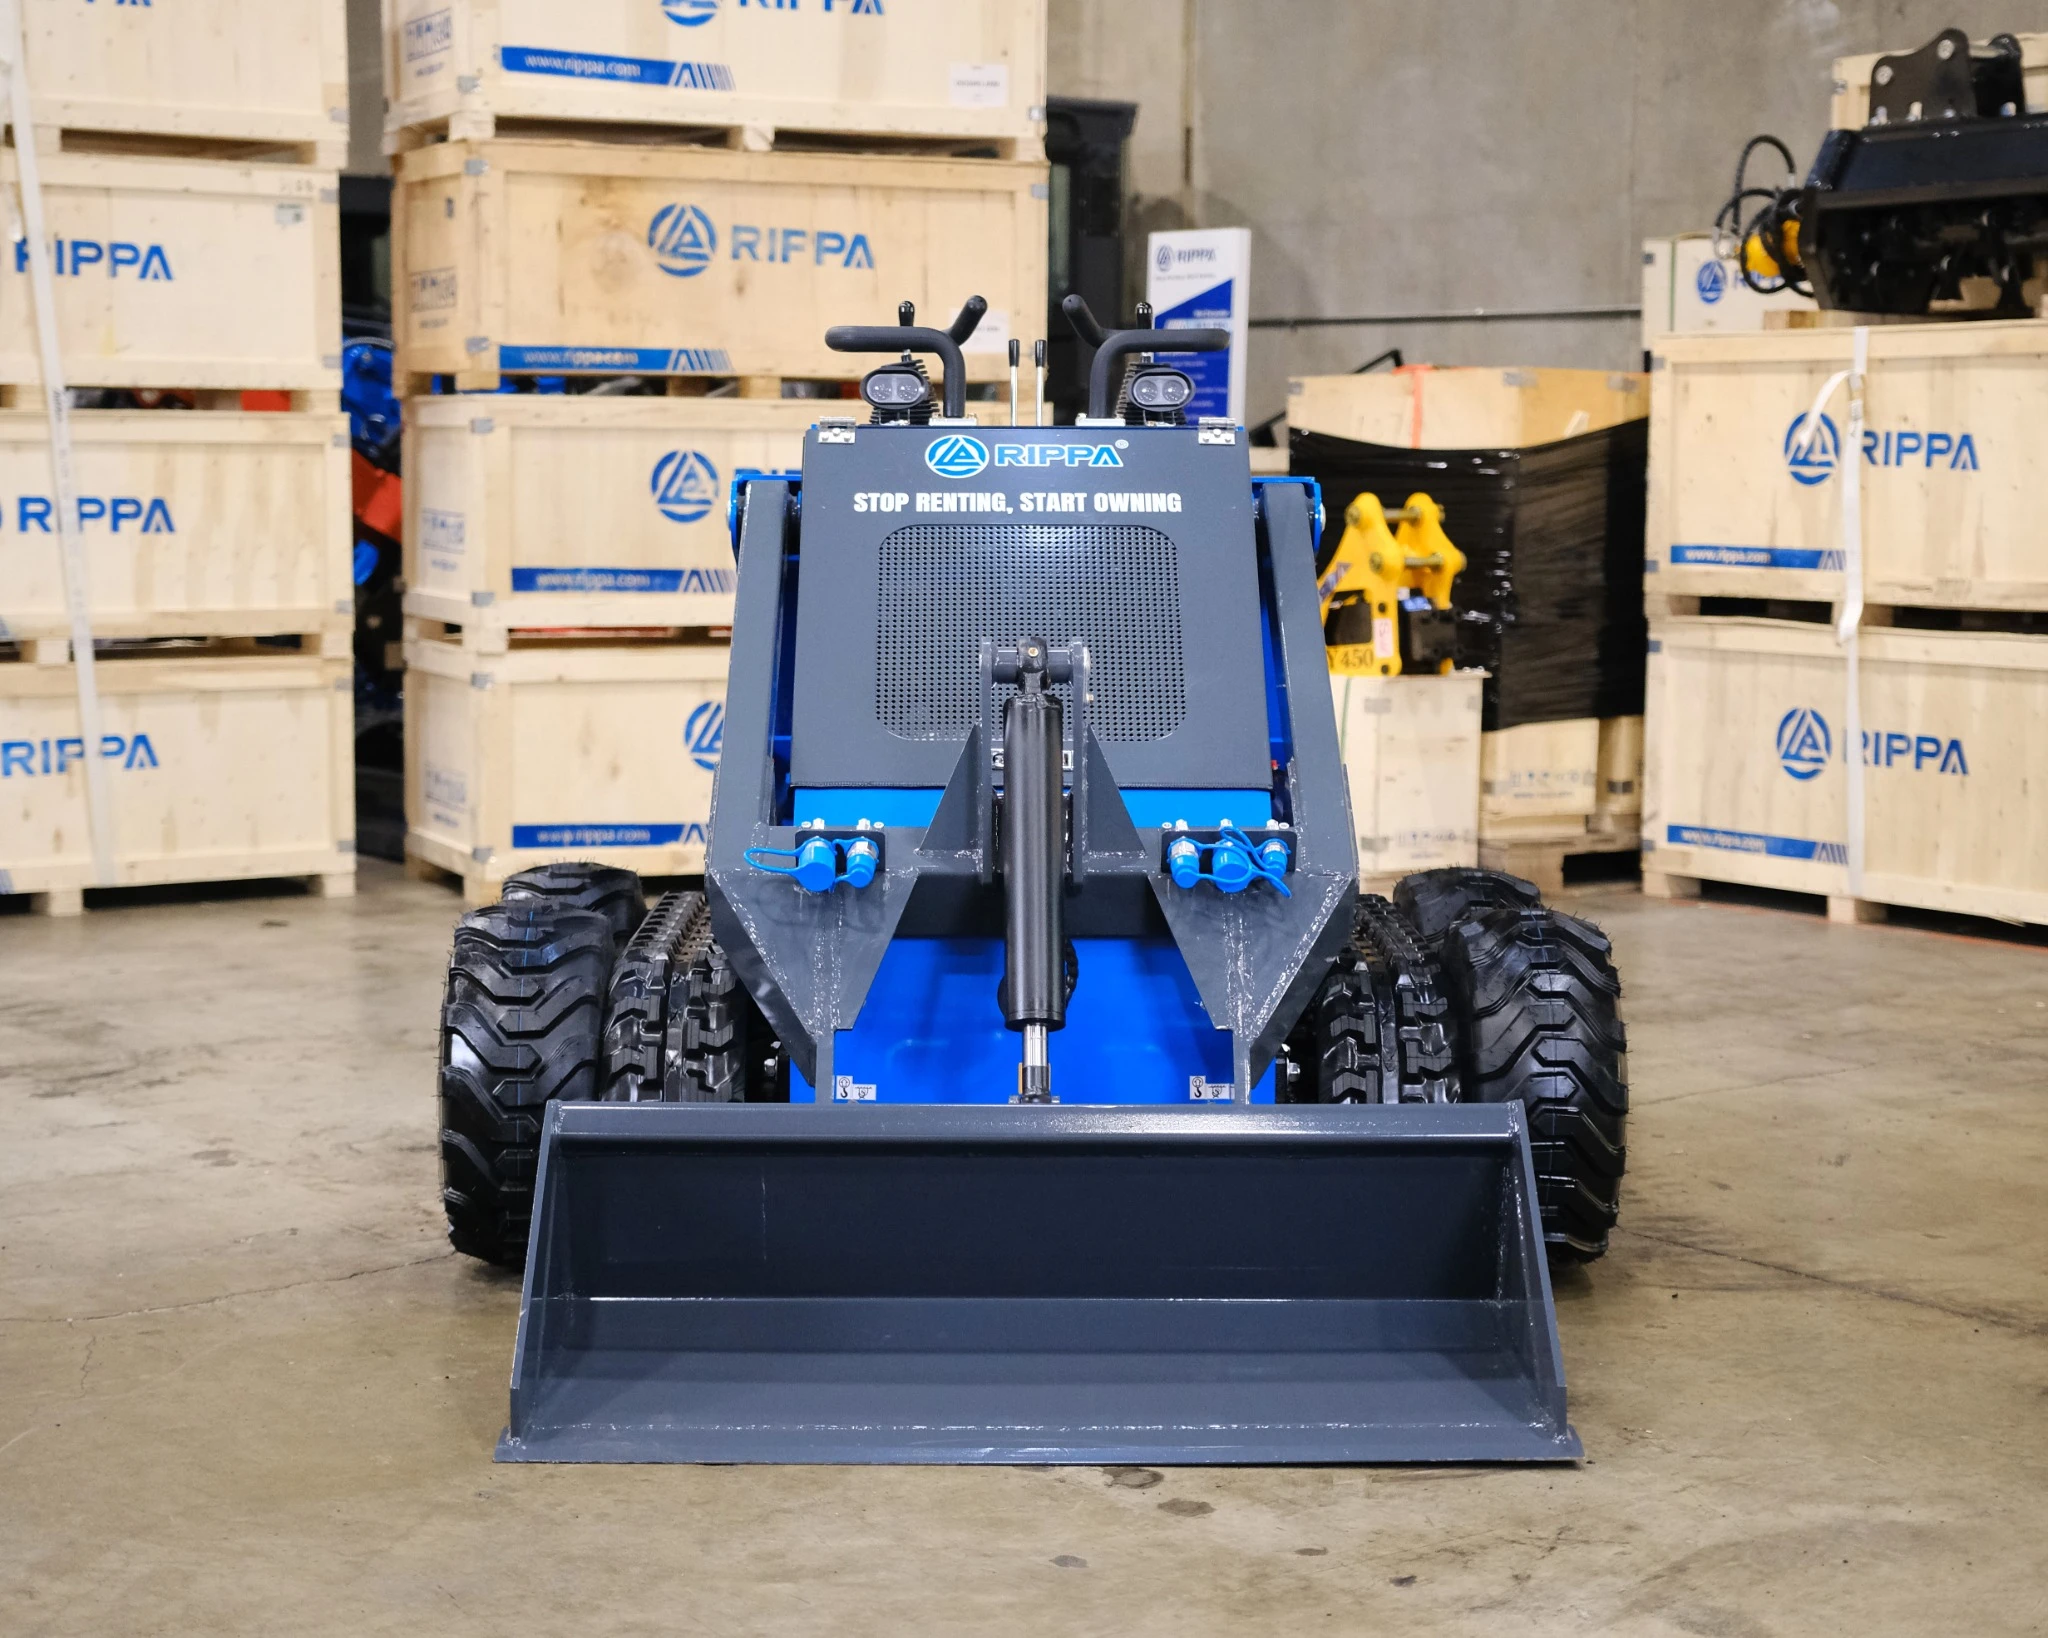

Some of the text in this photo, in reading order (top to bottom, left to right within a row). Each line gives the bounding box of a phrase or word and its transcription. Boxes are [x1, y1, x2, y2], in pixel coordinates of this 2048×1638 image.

[994, 444, 1124, 467] RIPPA
[853, 492, 1182, 514] STOP RENTING, START OWNING
[18, 497, 175, 533] RPPA
